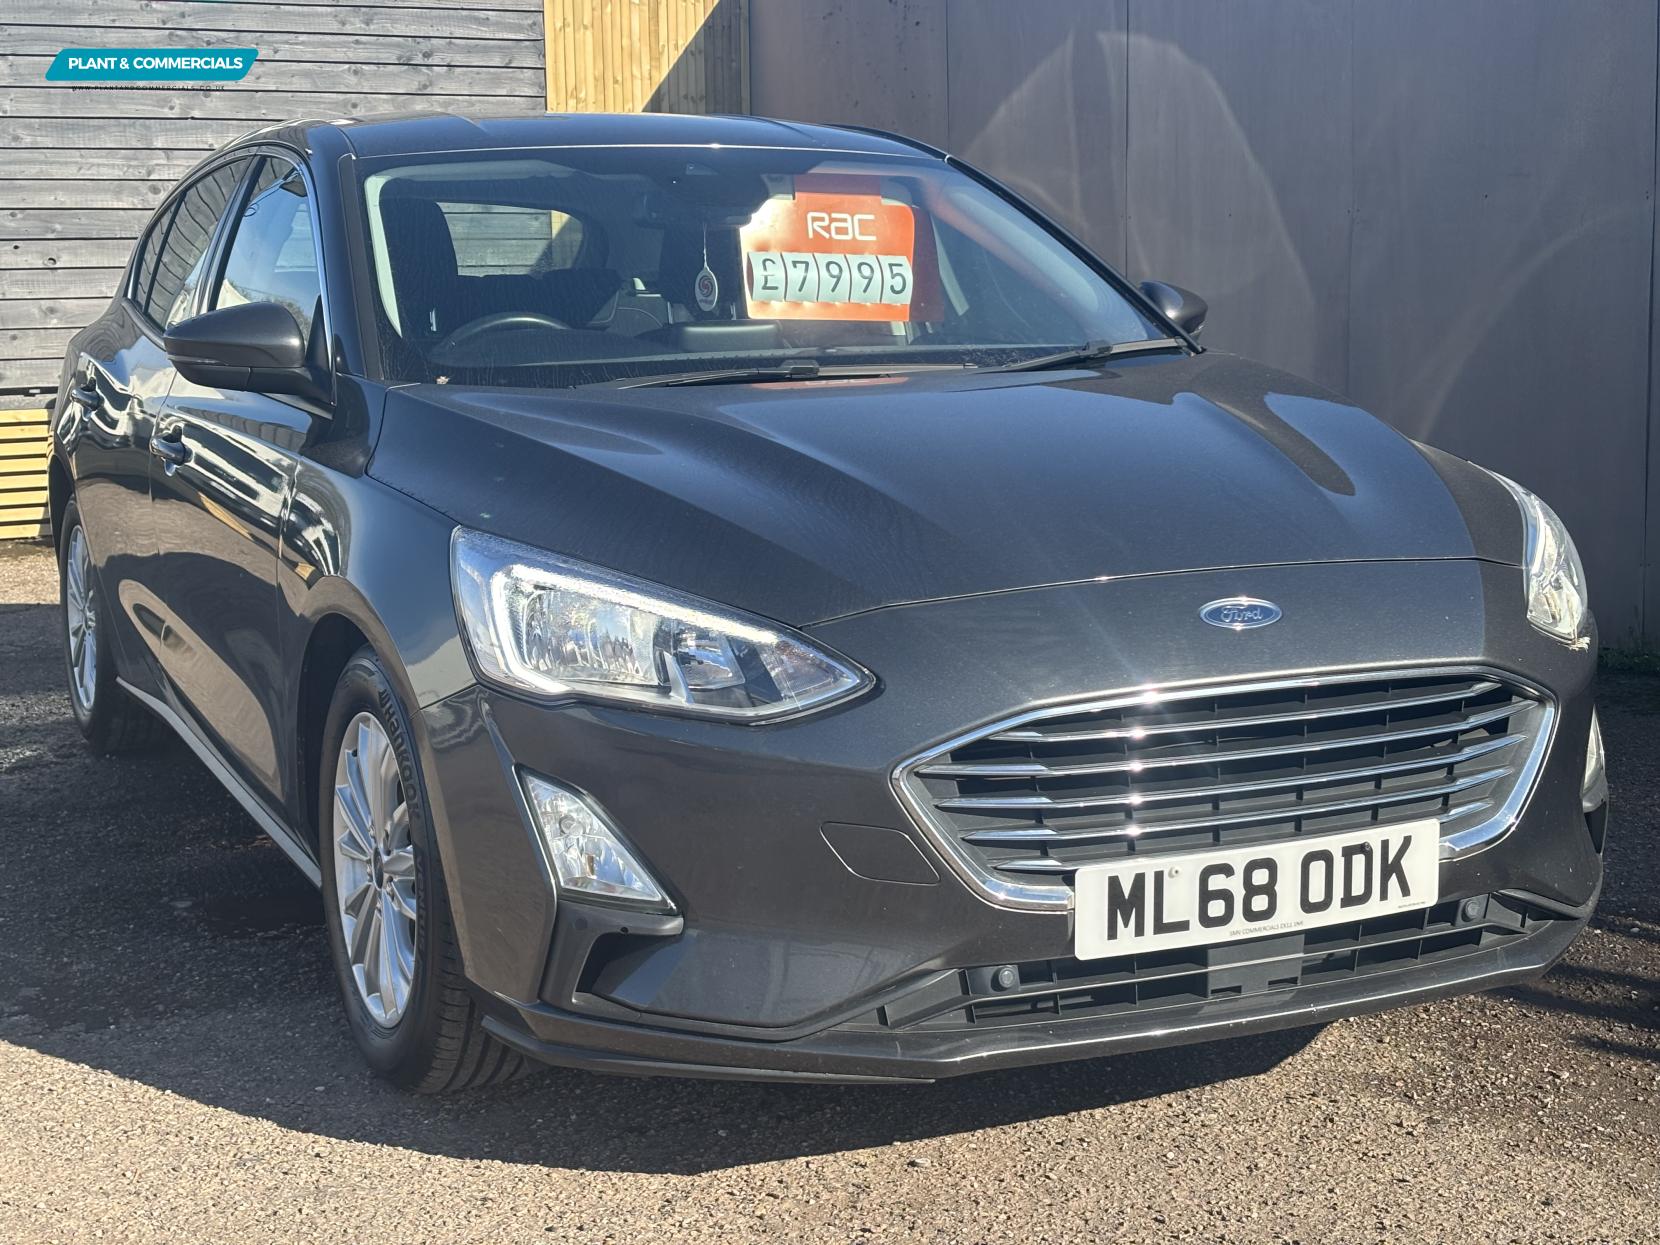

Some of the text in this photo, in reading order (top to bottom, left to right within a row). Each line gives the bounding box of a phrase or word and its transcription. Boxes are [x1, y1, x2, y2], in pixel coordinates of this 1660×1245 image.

[1220, 605, 1263, 622] Ford
[1106, 834, 1413, 941] ML68 ODK
